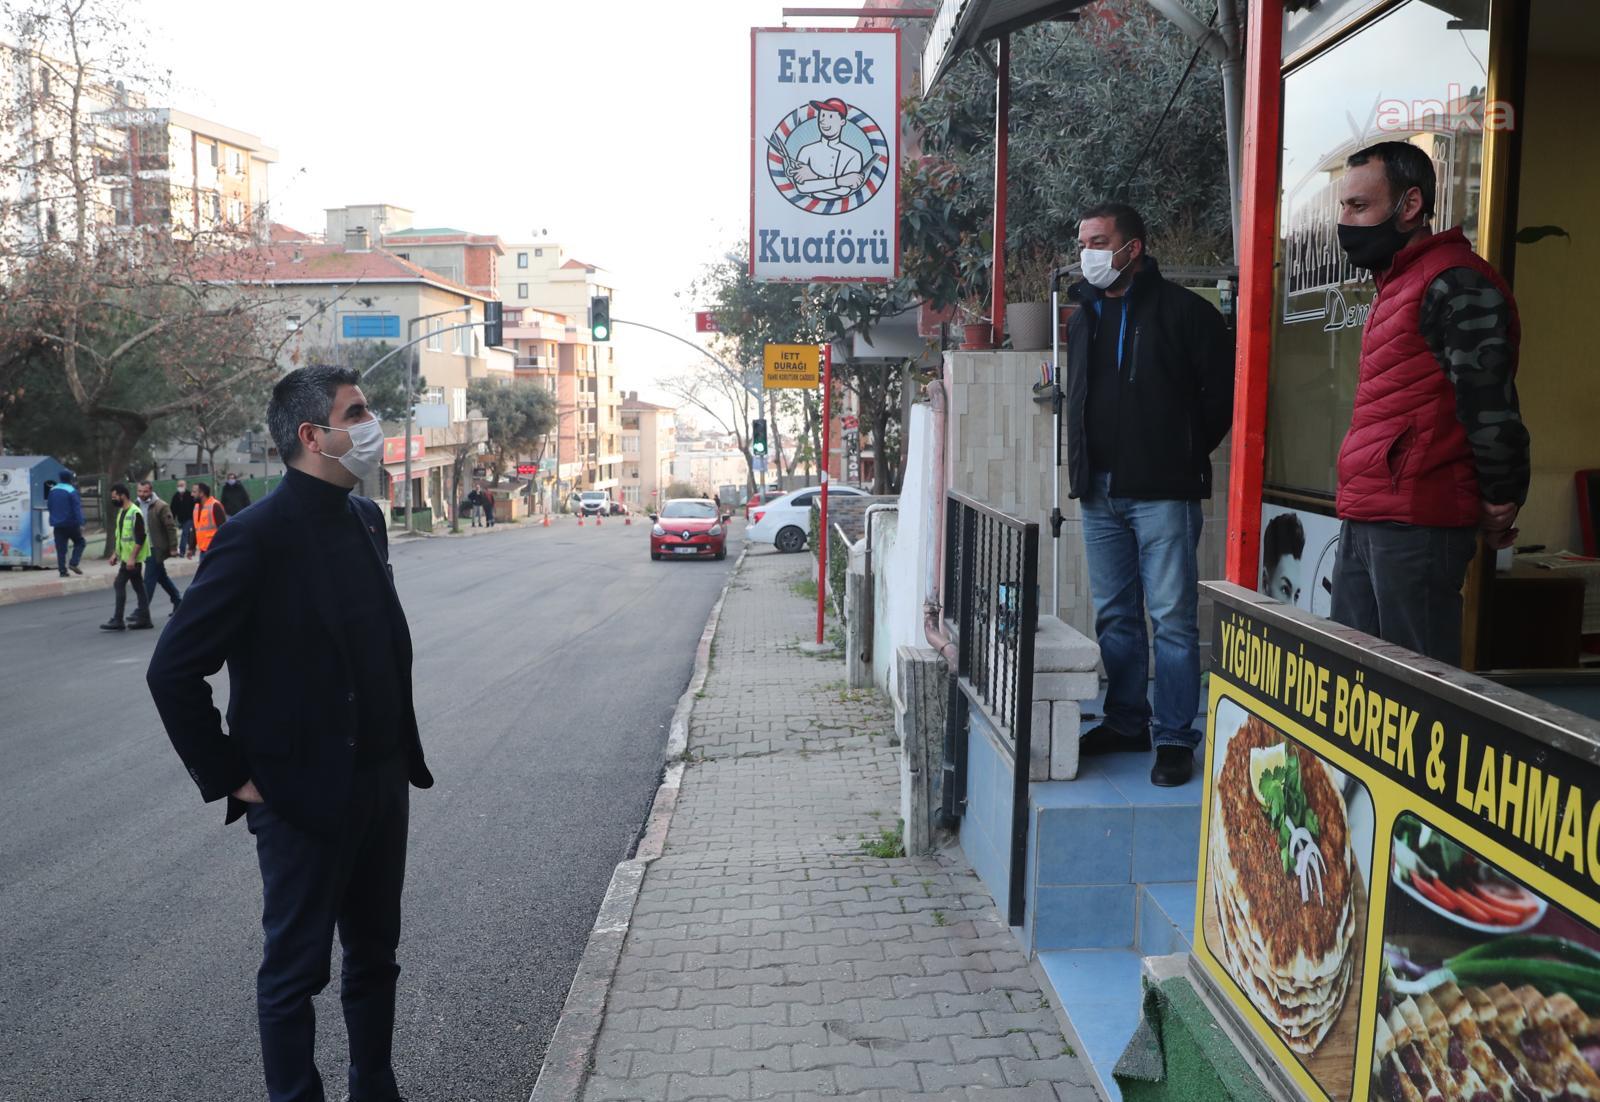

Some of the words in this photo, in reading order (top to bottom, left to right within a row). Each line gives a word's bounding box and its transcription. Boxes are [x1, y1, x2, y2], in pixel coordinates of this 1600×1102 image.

[777, 48, 875, 85] Erkek
[758, 229, 890, 265] Kuaförü
[1220, 613, 1282, 700] YİĞİDİM
[1283, 643, 1331, 728] PİDE
[1333, 670, 1421, 779] BÖREK
[1425, 721, 1446, 795] &
